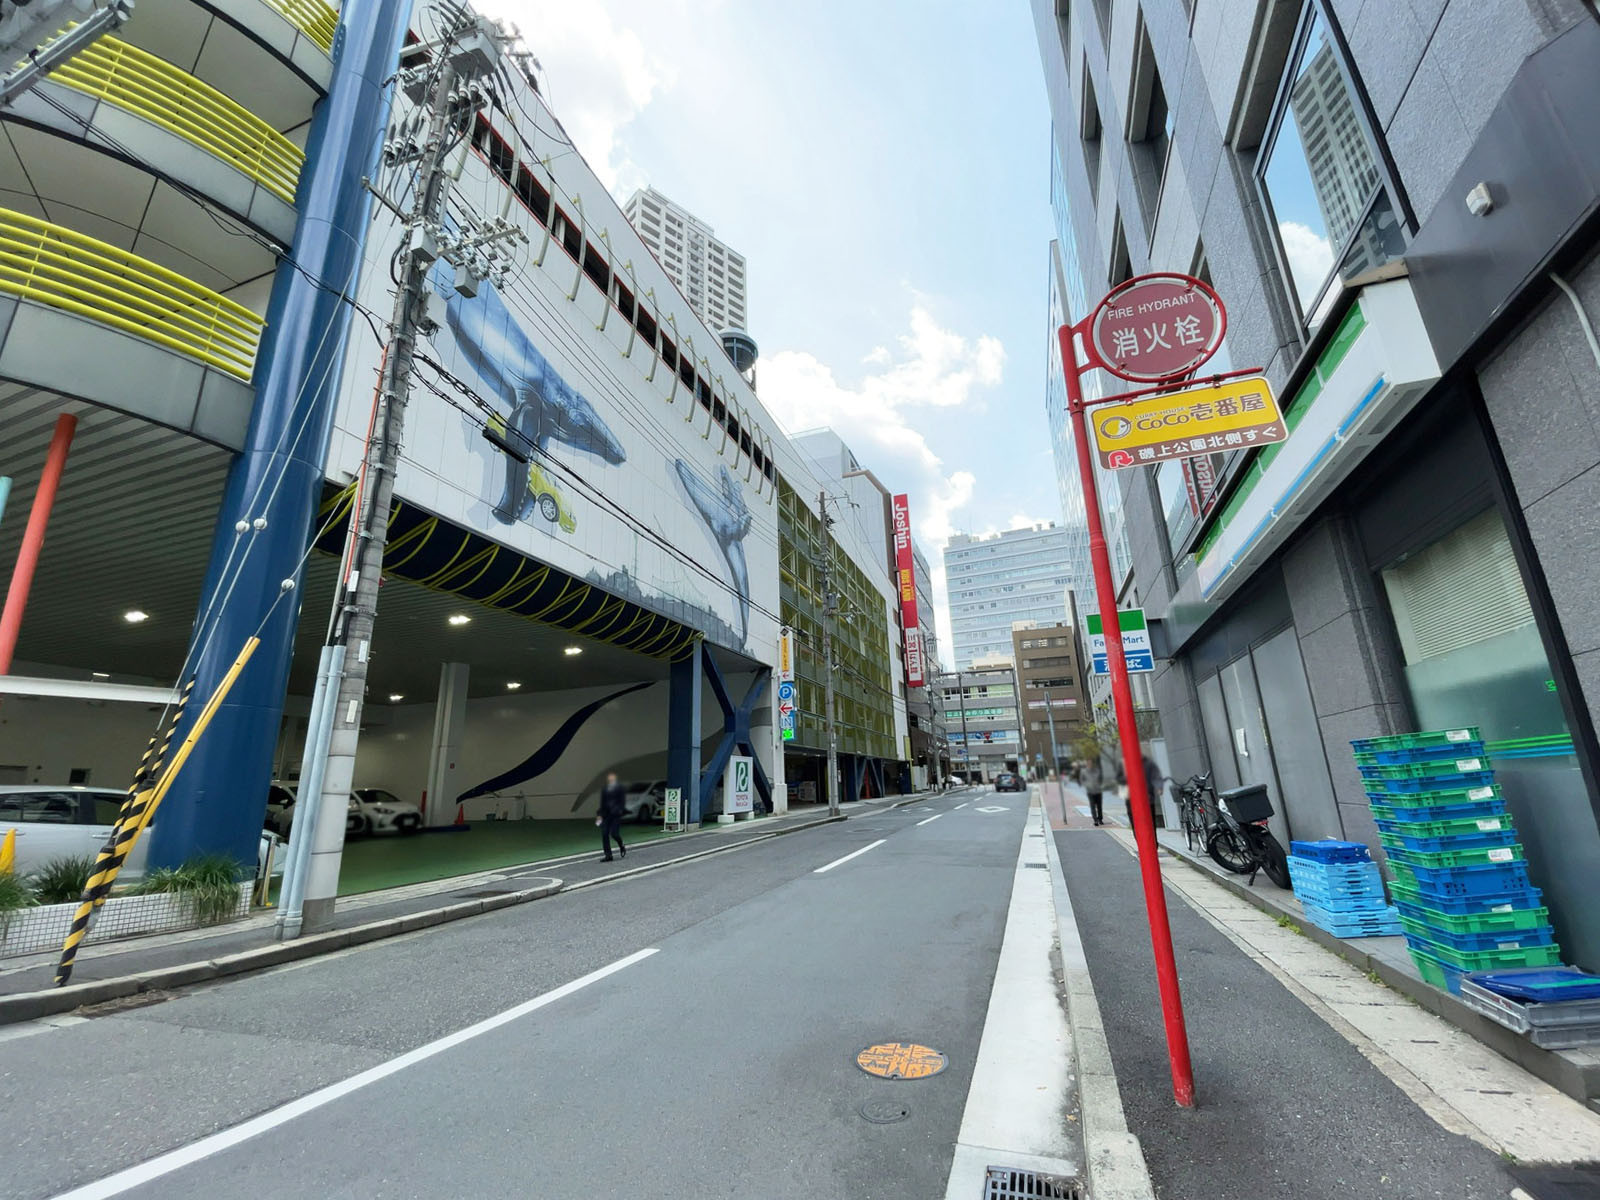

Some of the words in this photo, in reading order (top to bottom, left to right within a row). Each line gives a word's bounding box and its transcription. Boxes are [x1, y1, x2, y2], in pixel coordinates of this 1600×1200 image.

[1107, 306, 1134, 320] FIRE
[1138, 293, 1196, 314] HYDRANT
[1111, 314, 1205, 359] 消火栓
[895, 503, 909, 549] Joshin
[1093, 636, 1144, 647] FaMart
